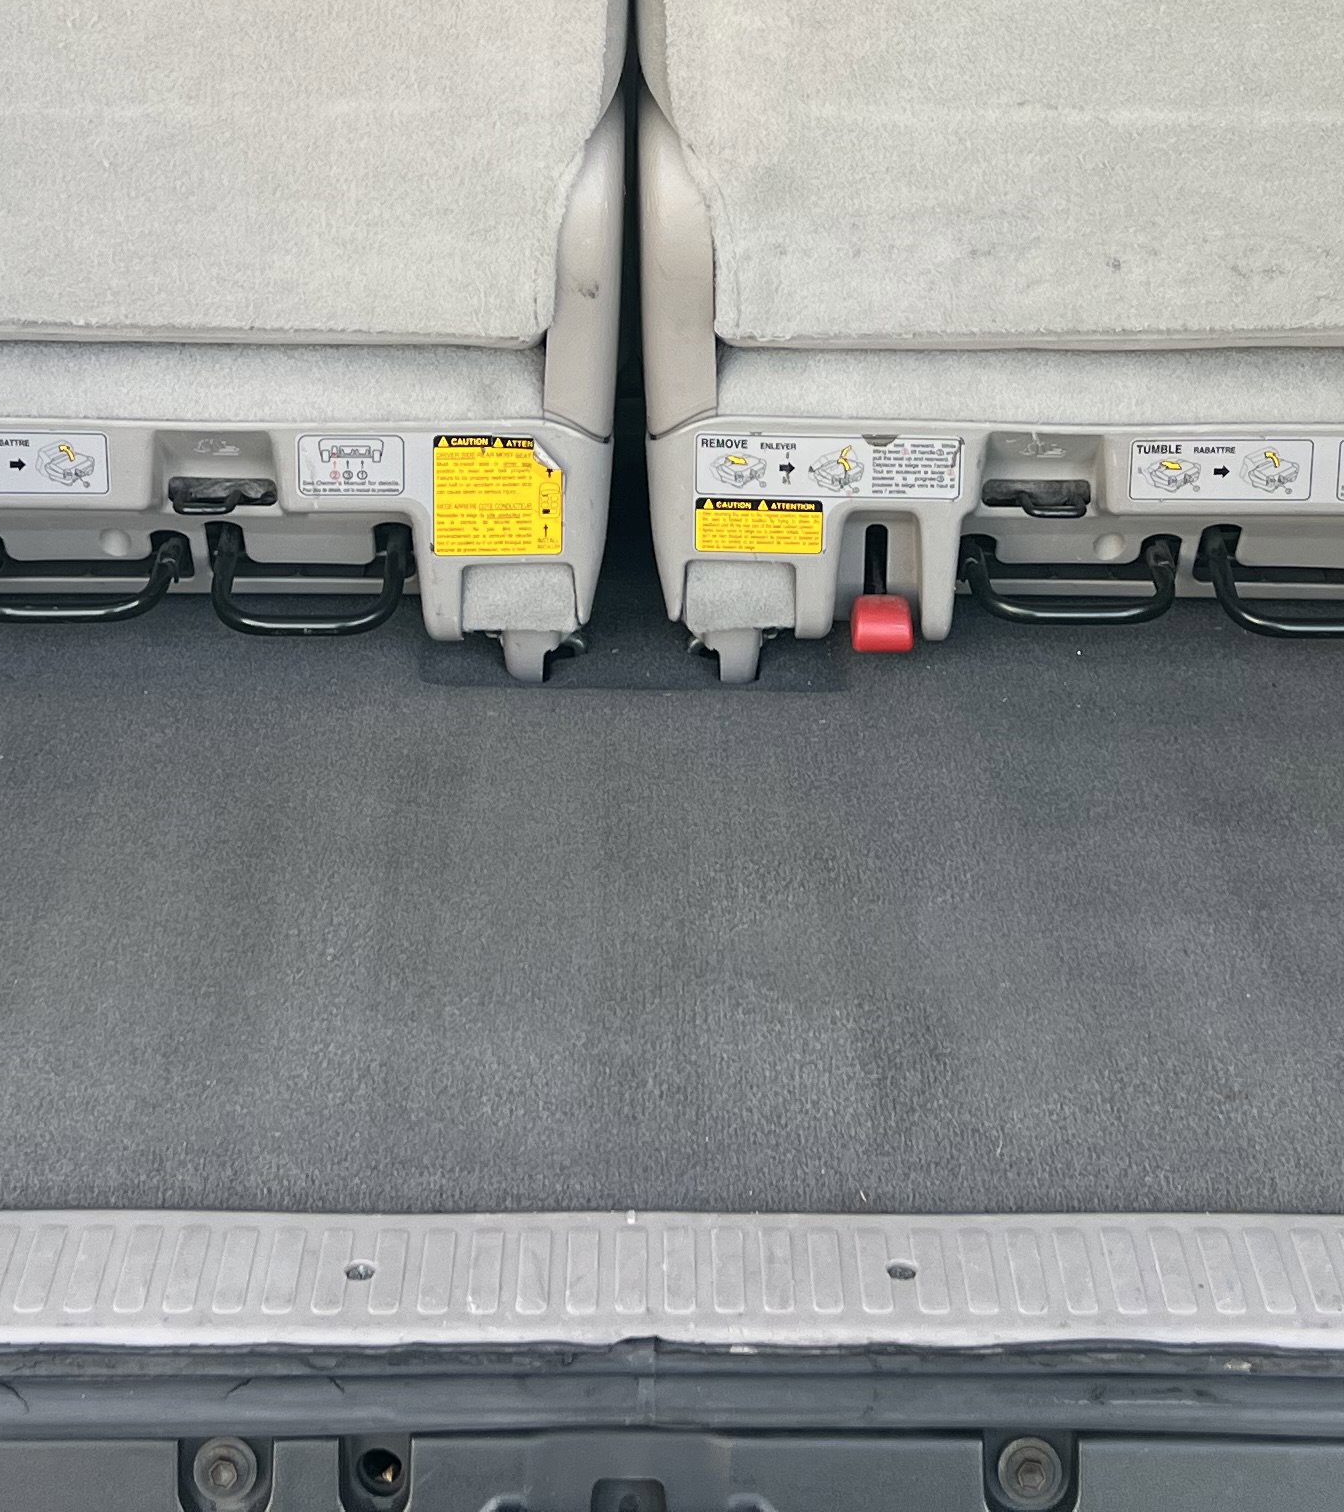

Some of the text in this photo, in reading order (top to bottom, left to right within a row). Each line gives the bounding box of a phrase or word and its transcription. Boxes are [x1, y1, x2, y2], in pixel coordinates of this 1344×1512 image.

[451, 437, 488, 447] CAUTION
[701, 438, 748, 449] REMOVE
[760, 442, 797, 450] ENLEVER
[1136, 444, 1182, 454] TUMBLE
[1193, 446, 1236, 454] RABATTRE
[715, 501, 752, 509] CAUTION
[771, 502, 816, 511] ATTENTION
